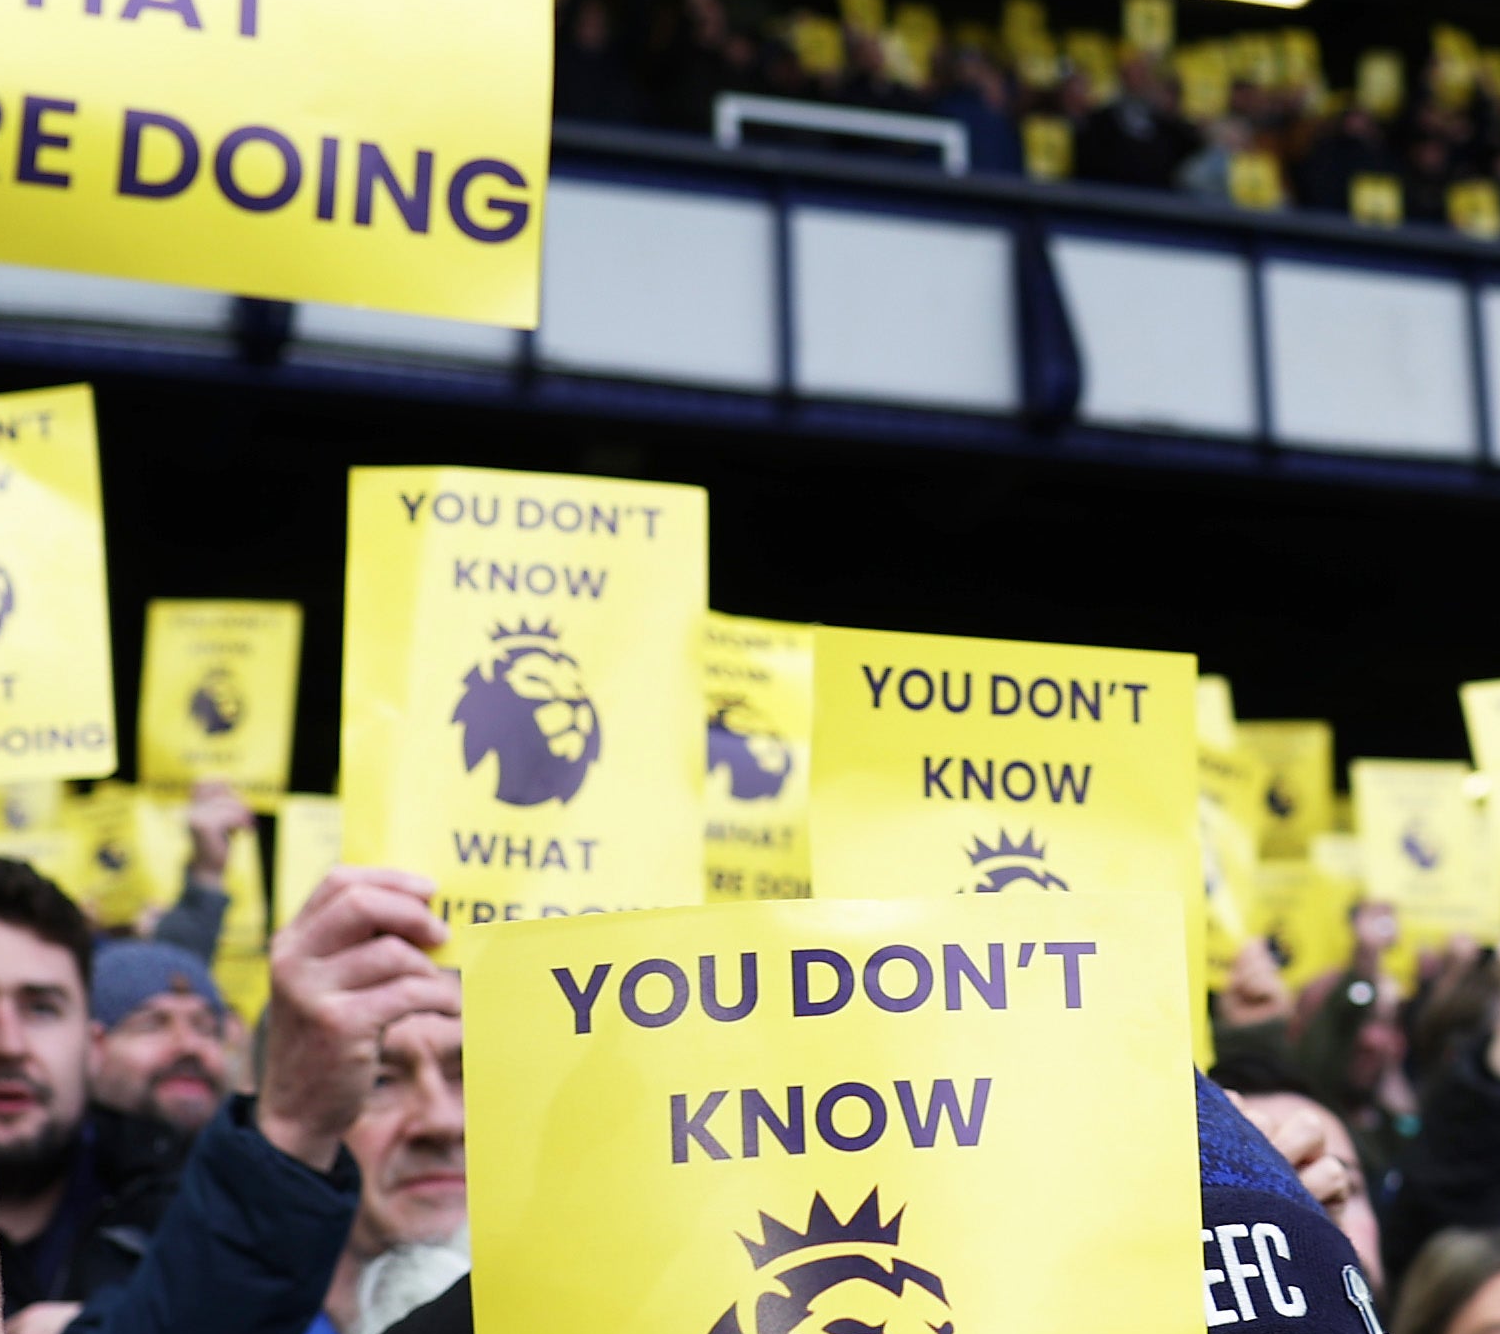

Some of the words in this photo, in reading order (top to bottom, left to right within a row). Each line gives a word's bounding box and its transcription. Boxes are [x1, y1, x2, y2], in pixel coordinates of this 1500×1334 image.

[114, 107, 531, 245] DOING
[399, 492, 499, 525] YOU
[516, 498, 663, 540] DON'T
[453, 558, 609, 600] KNOW
[862, 664, 971, 713] YOU
[991, 674, 1148, 724] DON'T
[923, 755, 1091, 804] KNOW
[453, 830, 601, 873] WHAT
[552, 950, 758, 1036] YOU
[790, 941, 1096, 1019] DON'T
[669, 1077, 993, 1163] KNOW
[1201, 1222, 1307, 1327] EFC
